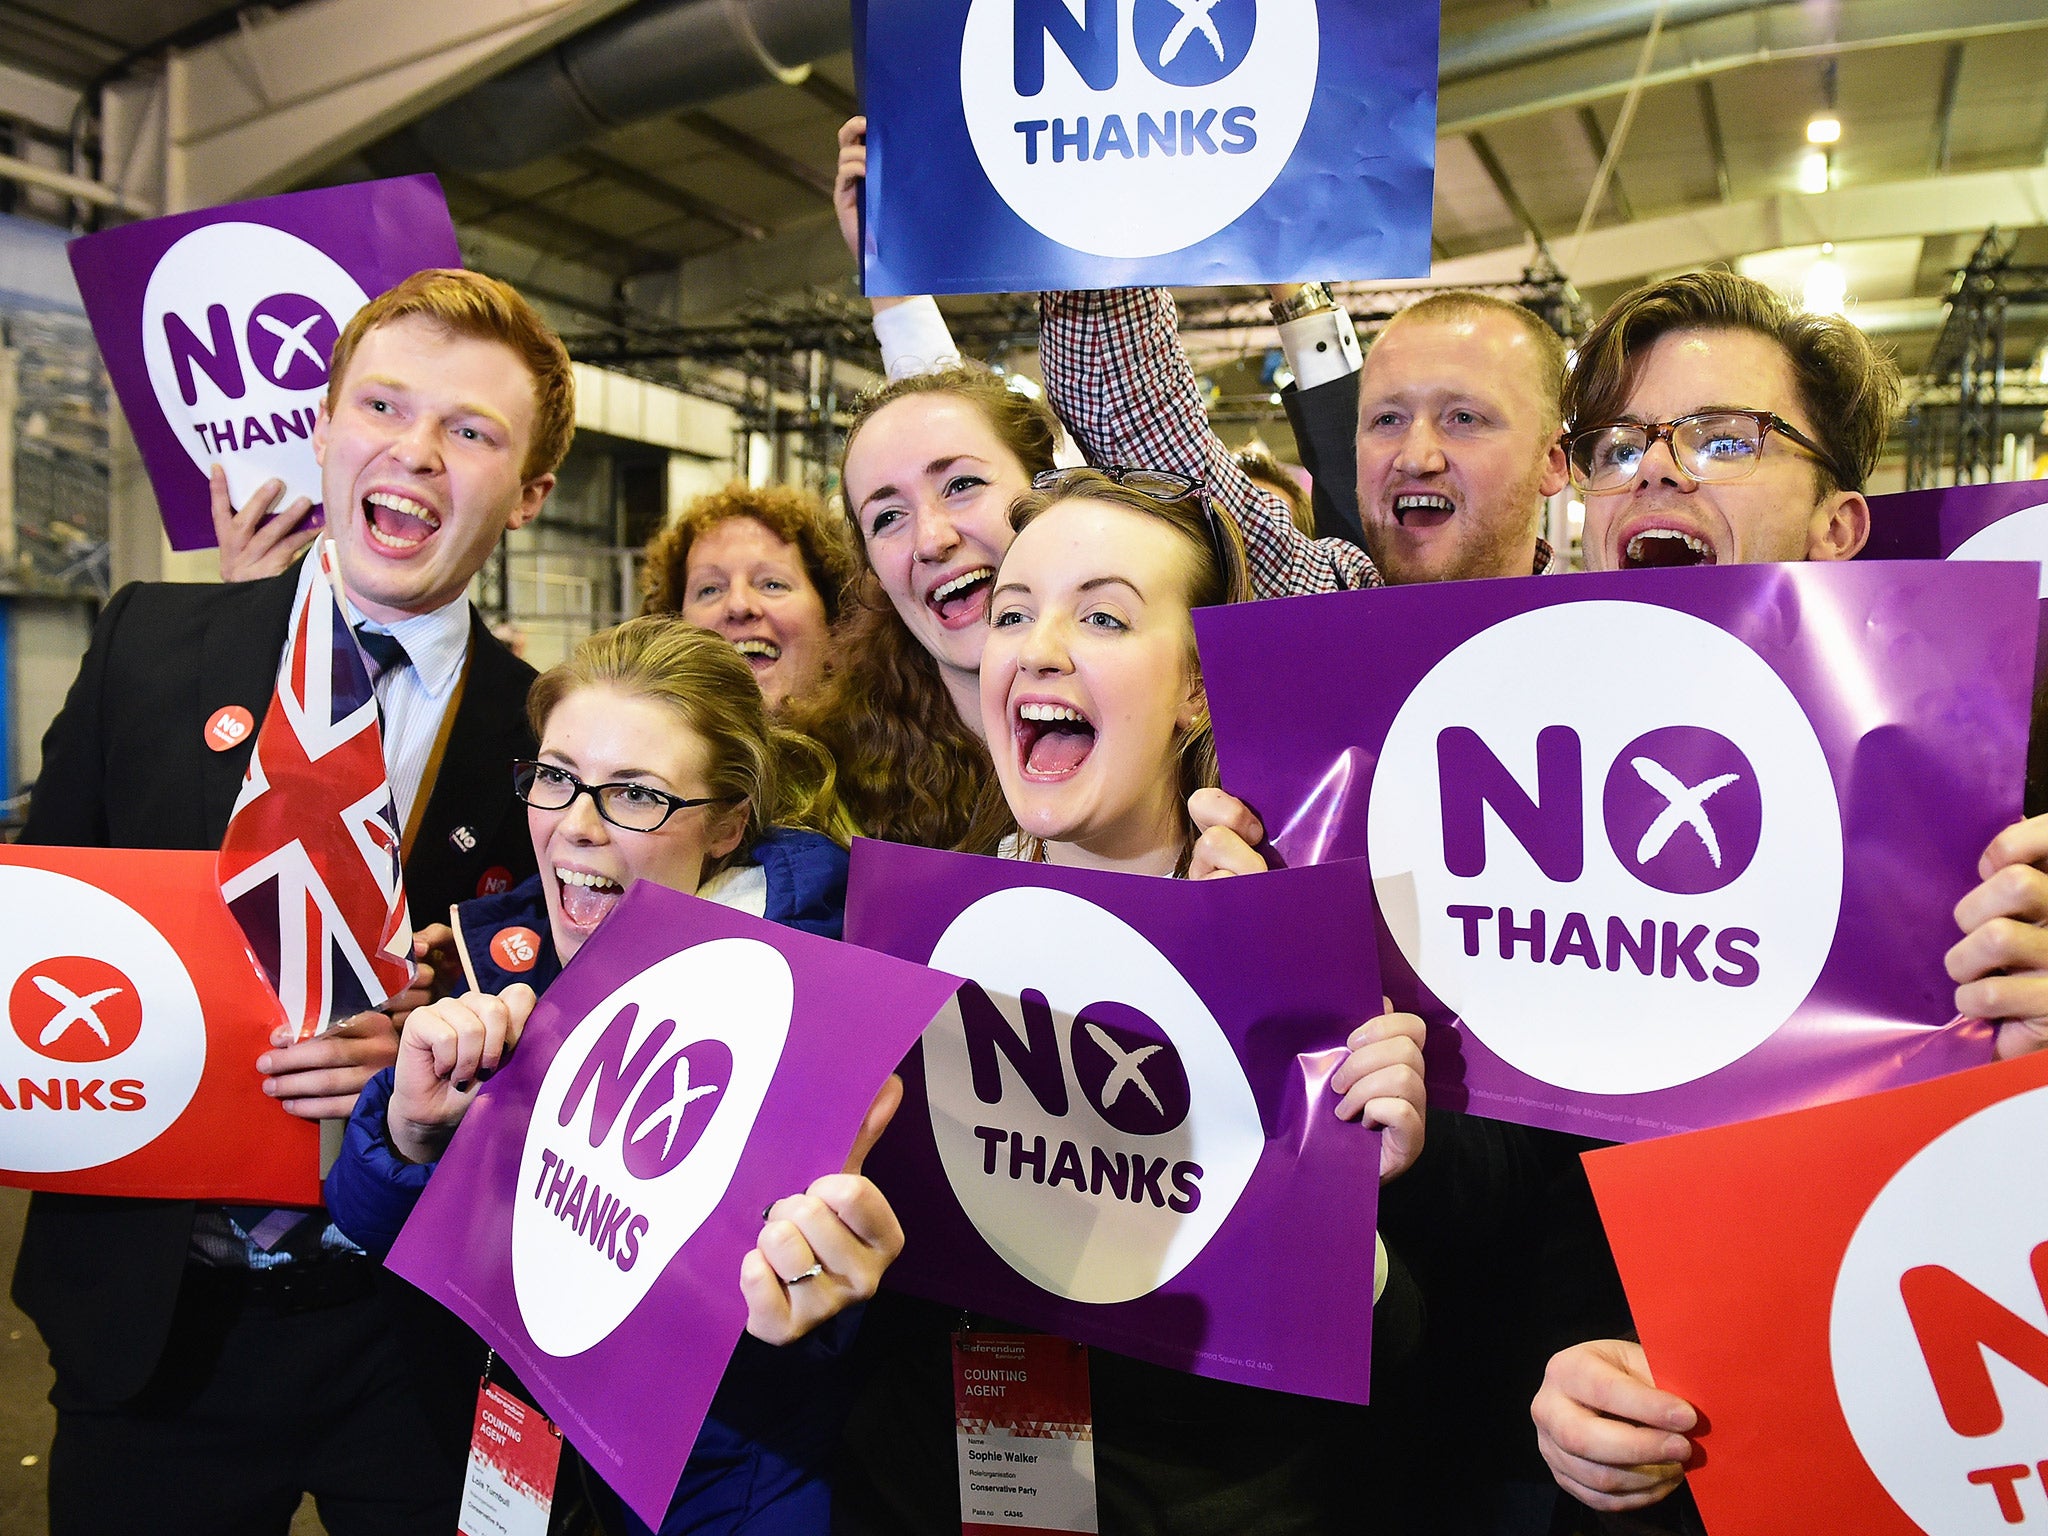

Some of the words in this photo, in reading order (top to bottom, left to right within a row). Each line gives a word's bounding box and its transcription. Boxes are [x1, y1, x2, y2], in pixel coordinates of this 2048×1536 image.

[1013, 0, 1257, 97] NO
[1014, 105, 1258, 165] THANKS
[163, 292, 341, 406] NO
[216, 713, 246, 738] NO
[1436, 724, 1762, 894] NO
[455, 826, 477, 849] NO
[485, 876, 507, 893] NO
[507, 932, 534, 961] NO
[1446, 904, 1760, 988] THANKS
[956, 979, 1191, 1136] NO
[558, 1002, 733, 1180] NO
[974, 1125, 1204, 1214] THANKS
[534, 1148, 649, 1273] THANKS
[964, 1368, 1028, 1382] COUNTING
[965, 1385, 1007, 1398] AGENT
[480, 1423, 507, 1447] AGENT
[482, 1409, 522, 1443] COUNTING
[968, 1449, 1003, 1463] Sophie
[1004, 1451, 1039, 1464] Walker
[970, 1483, 1017, 1494] Conservative
[1018, 1486, 1038, 1497] Party
